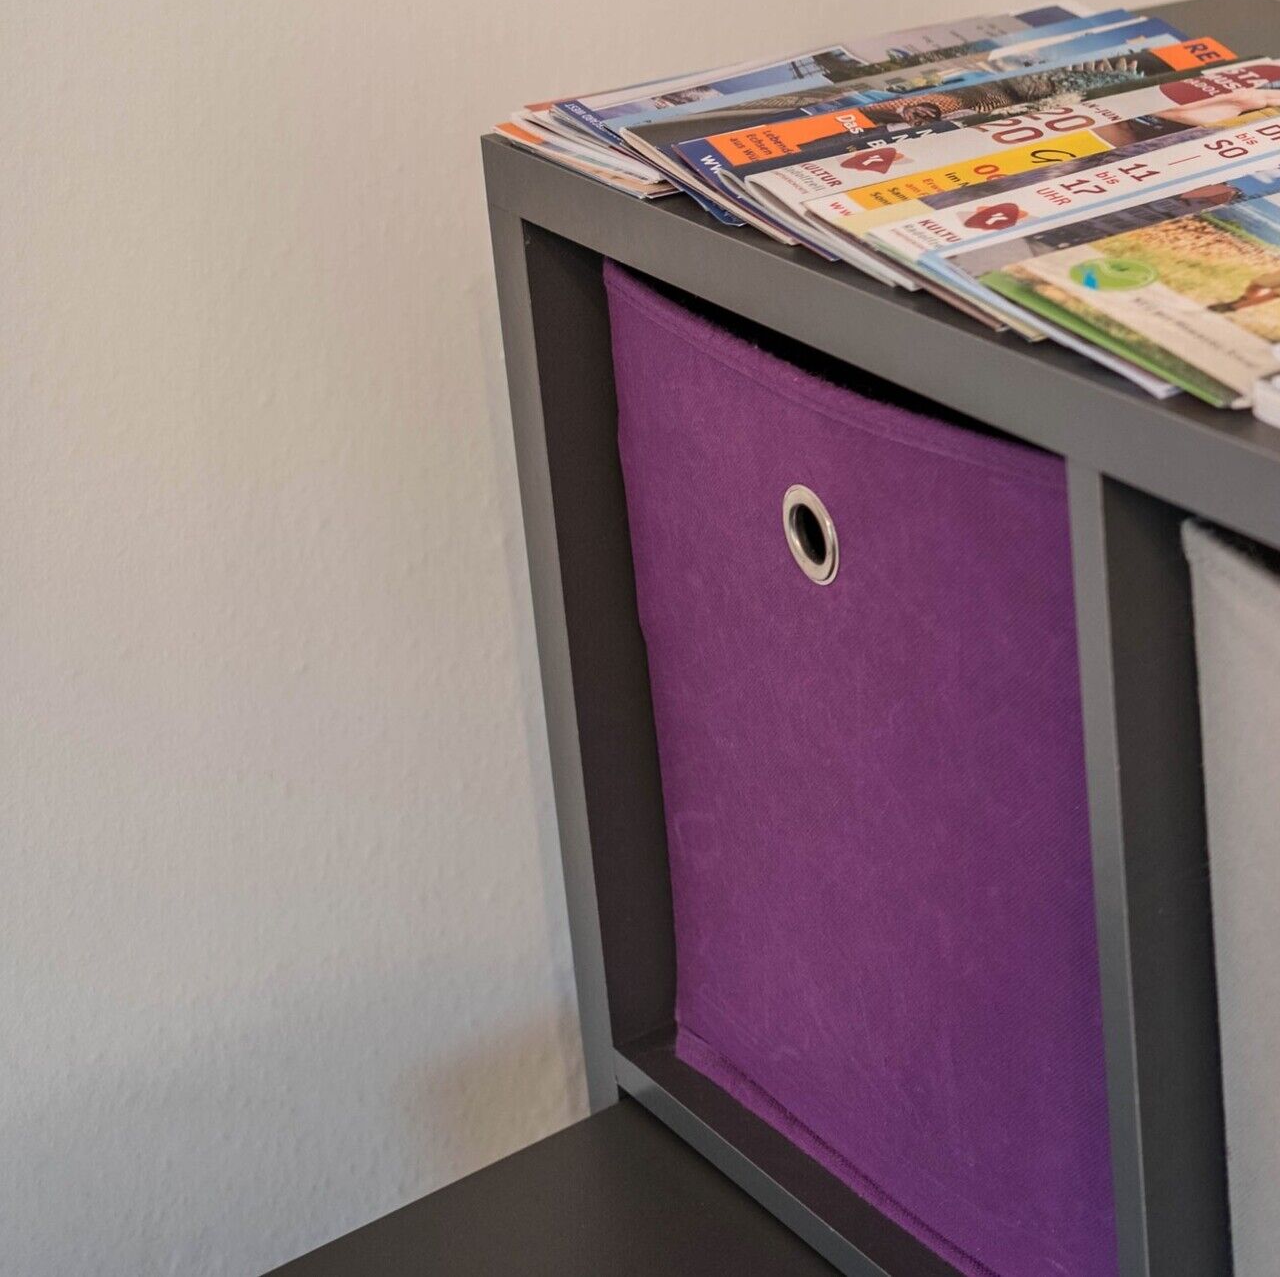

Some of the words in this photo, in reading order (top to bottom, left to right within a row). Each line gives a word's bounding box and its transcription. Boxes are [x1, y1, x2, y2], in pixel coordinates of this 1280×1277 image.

[835, 114, 865, 137] Das
[1234, 132, 1258, 145] bis
[1204, 139, 1249, 159] SO
[801, 163, 843, 189] KULTUR
[1095, 171, 1121, 185] bis
[1118, 163, 1161, 182] 11
[1060, 179, 1107, 195] 17
[1036, 187, 1073, 207] UHR
